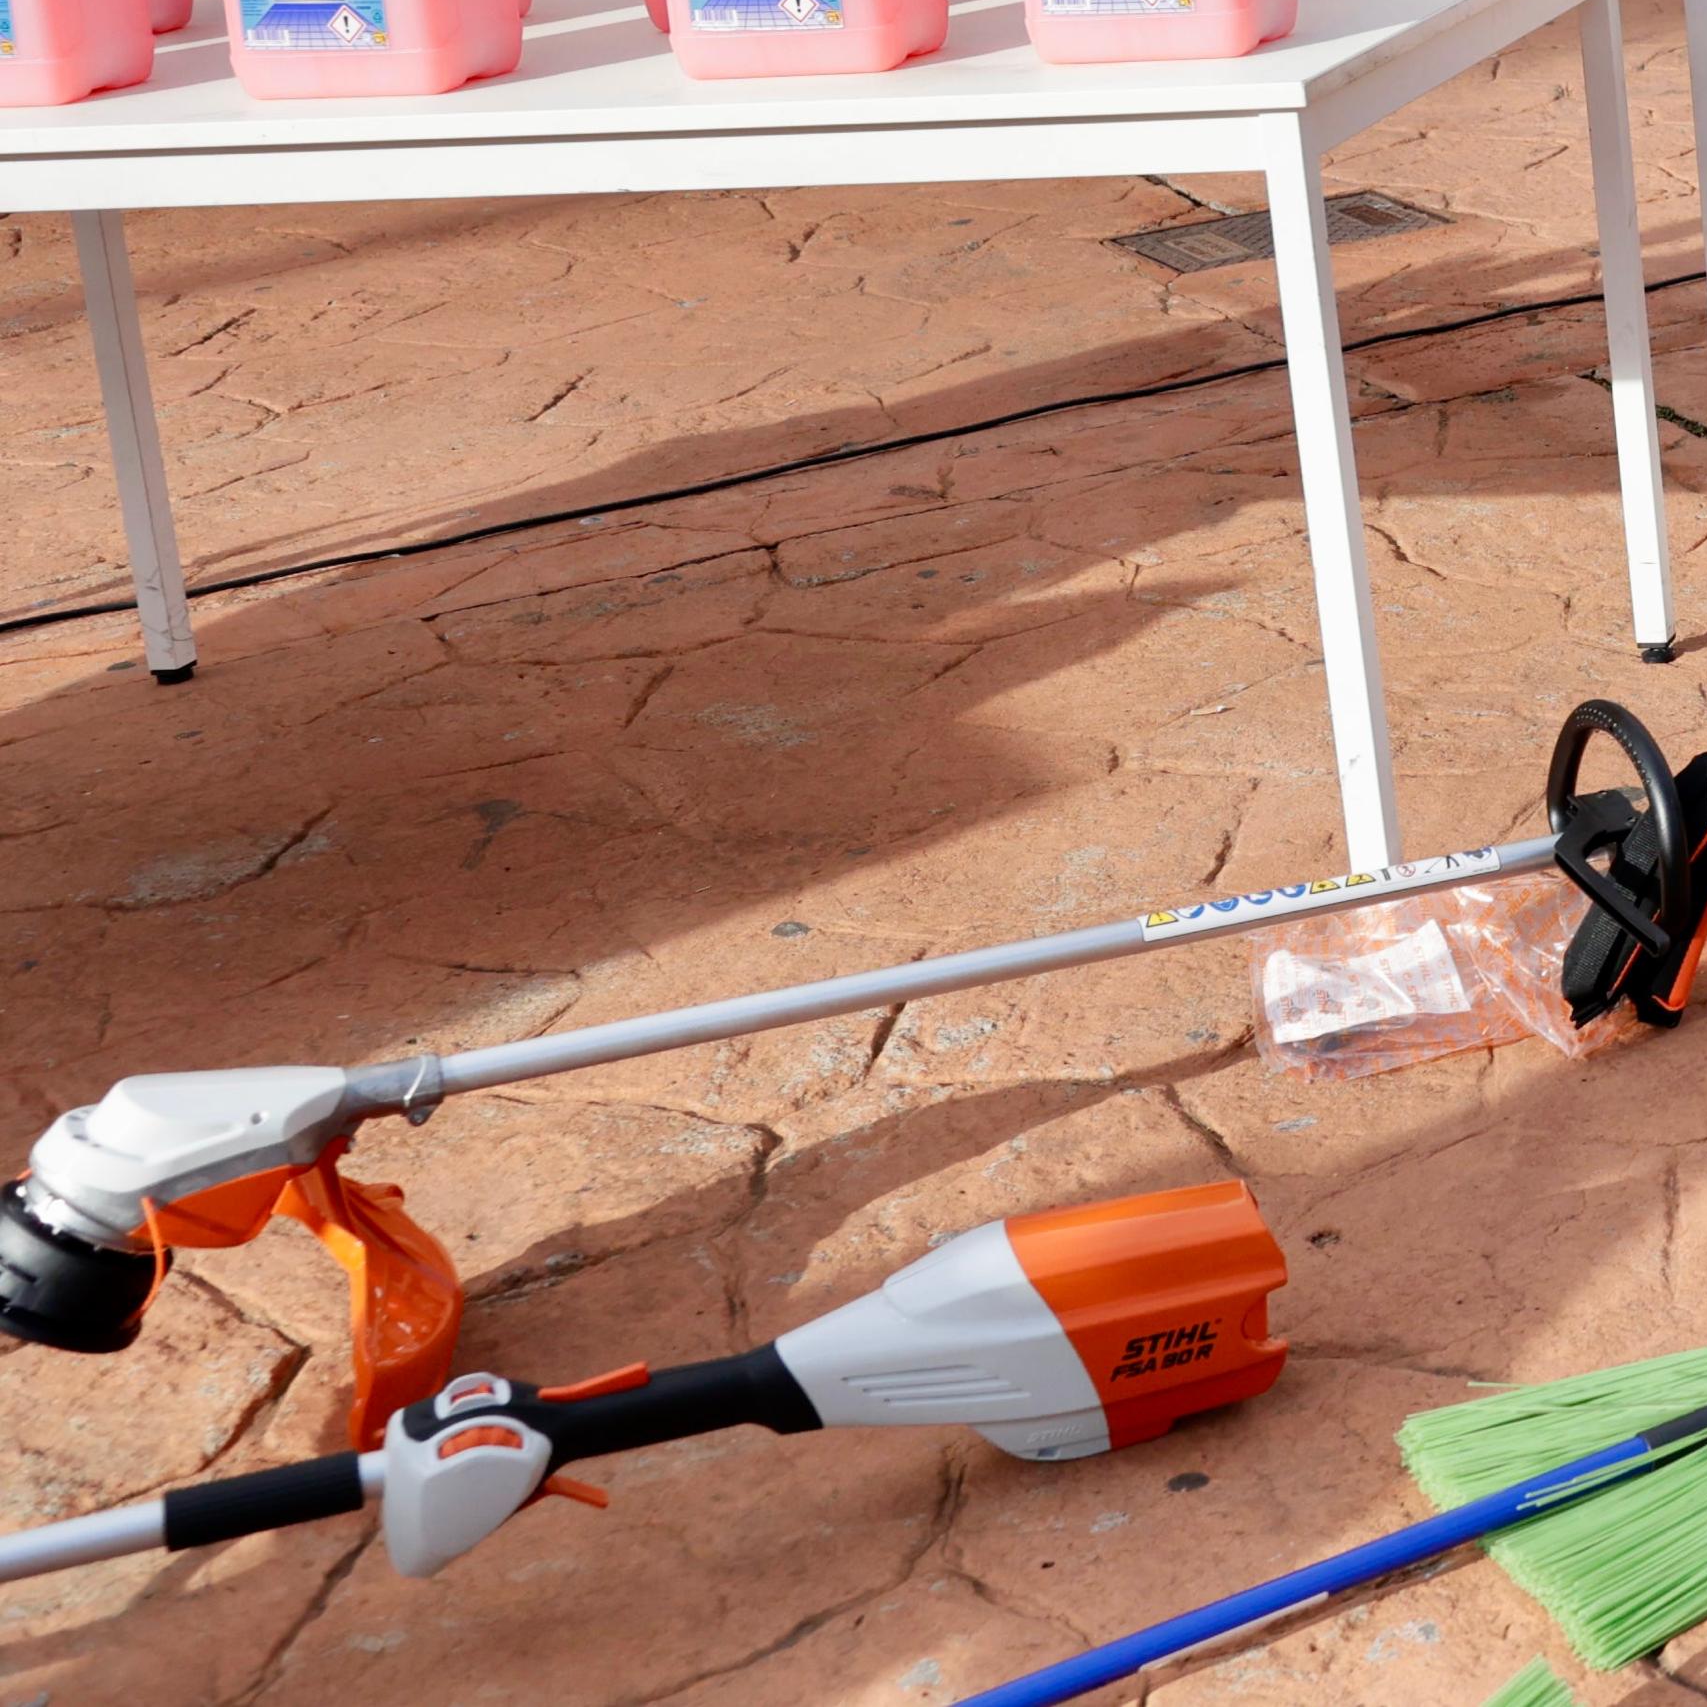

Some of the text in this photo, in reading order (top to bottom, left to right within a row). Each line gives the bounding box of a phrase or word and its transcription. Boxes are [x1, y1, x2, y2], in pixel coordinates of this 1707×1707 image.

[1121, 1321, 1218, 1362] STIHL
[1110, 1360, 1158, 1383] FSA
[1192, 1343, 1215, 1363] R
